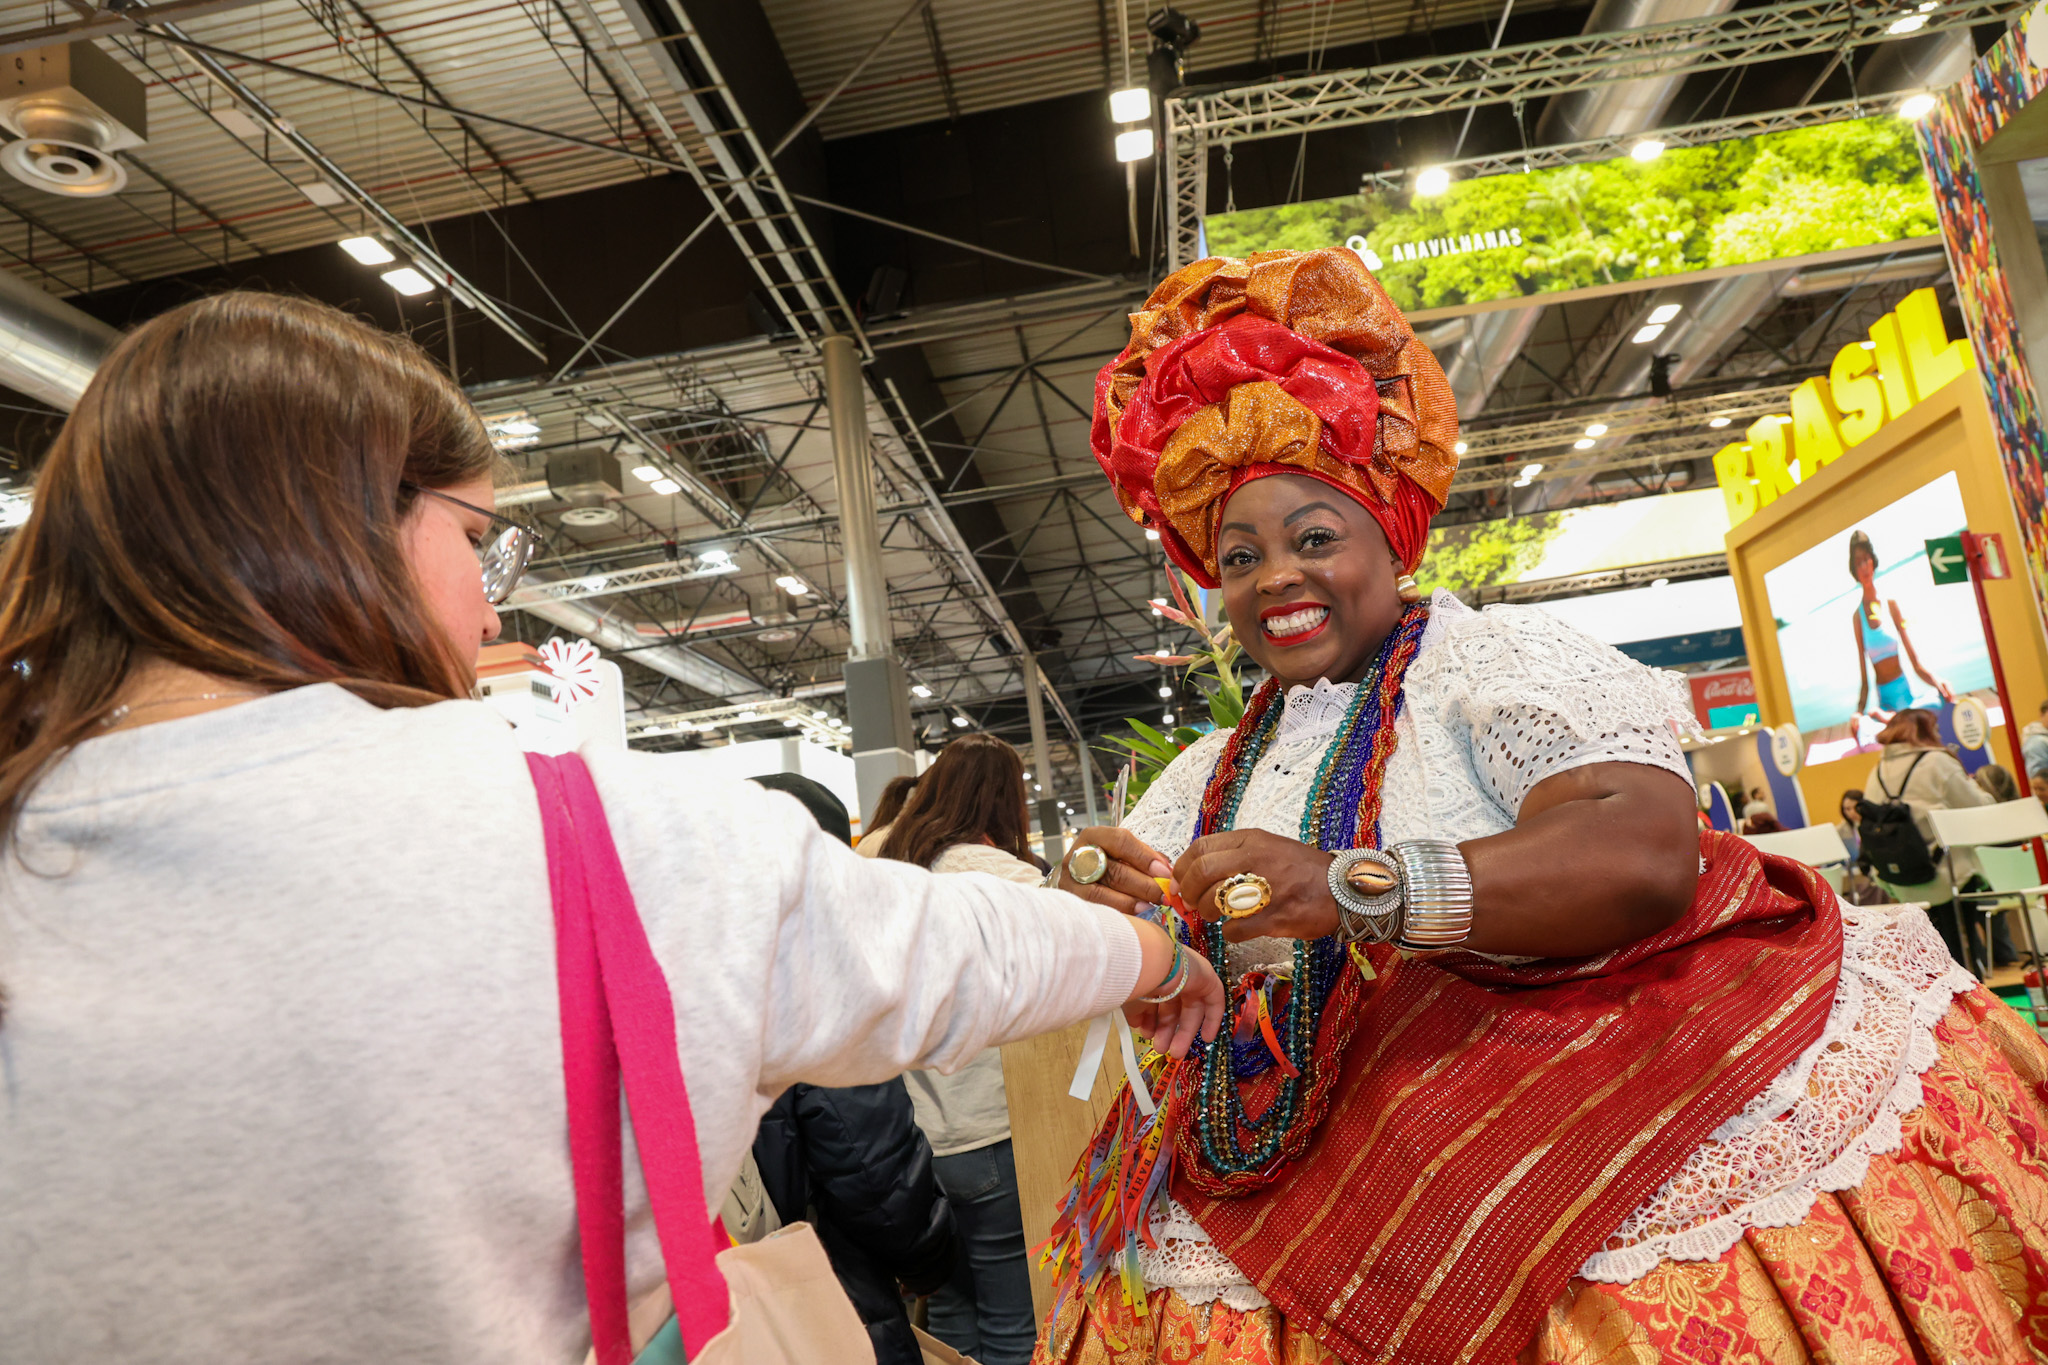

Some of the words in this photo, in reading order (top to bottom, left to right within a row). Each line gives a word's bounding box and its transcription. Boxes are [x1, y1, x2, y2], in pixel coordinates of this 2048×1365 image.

[1393, 228, 1522, 263] ANAVILHANAS
[1712, 287, 1977, 530] BRASIL
[1152, 1062, 1177, 1103] SENHO
[1096, 1120, 1113, 1159] BAHIA
[1149, 1135, 1160, 1151] DA
[1111, 1159, 1122, 1192] AHIA
[1128, 1158, 1152, 1200] BAHIA
